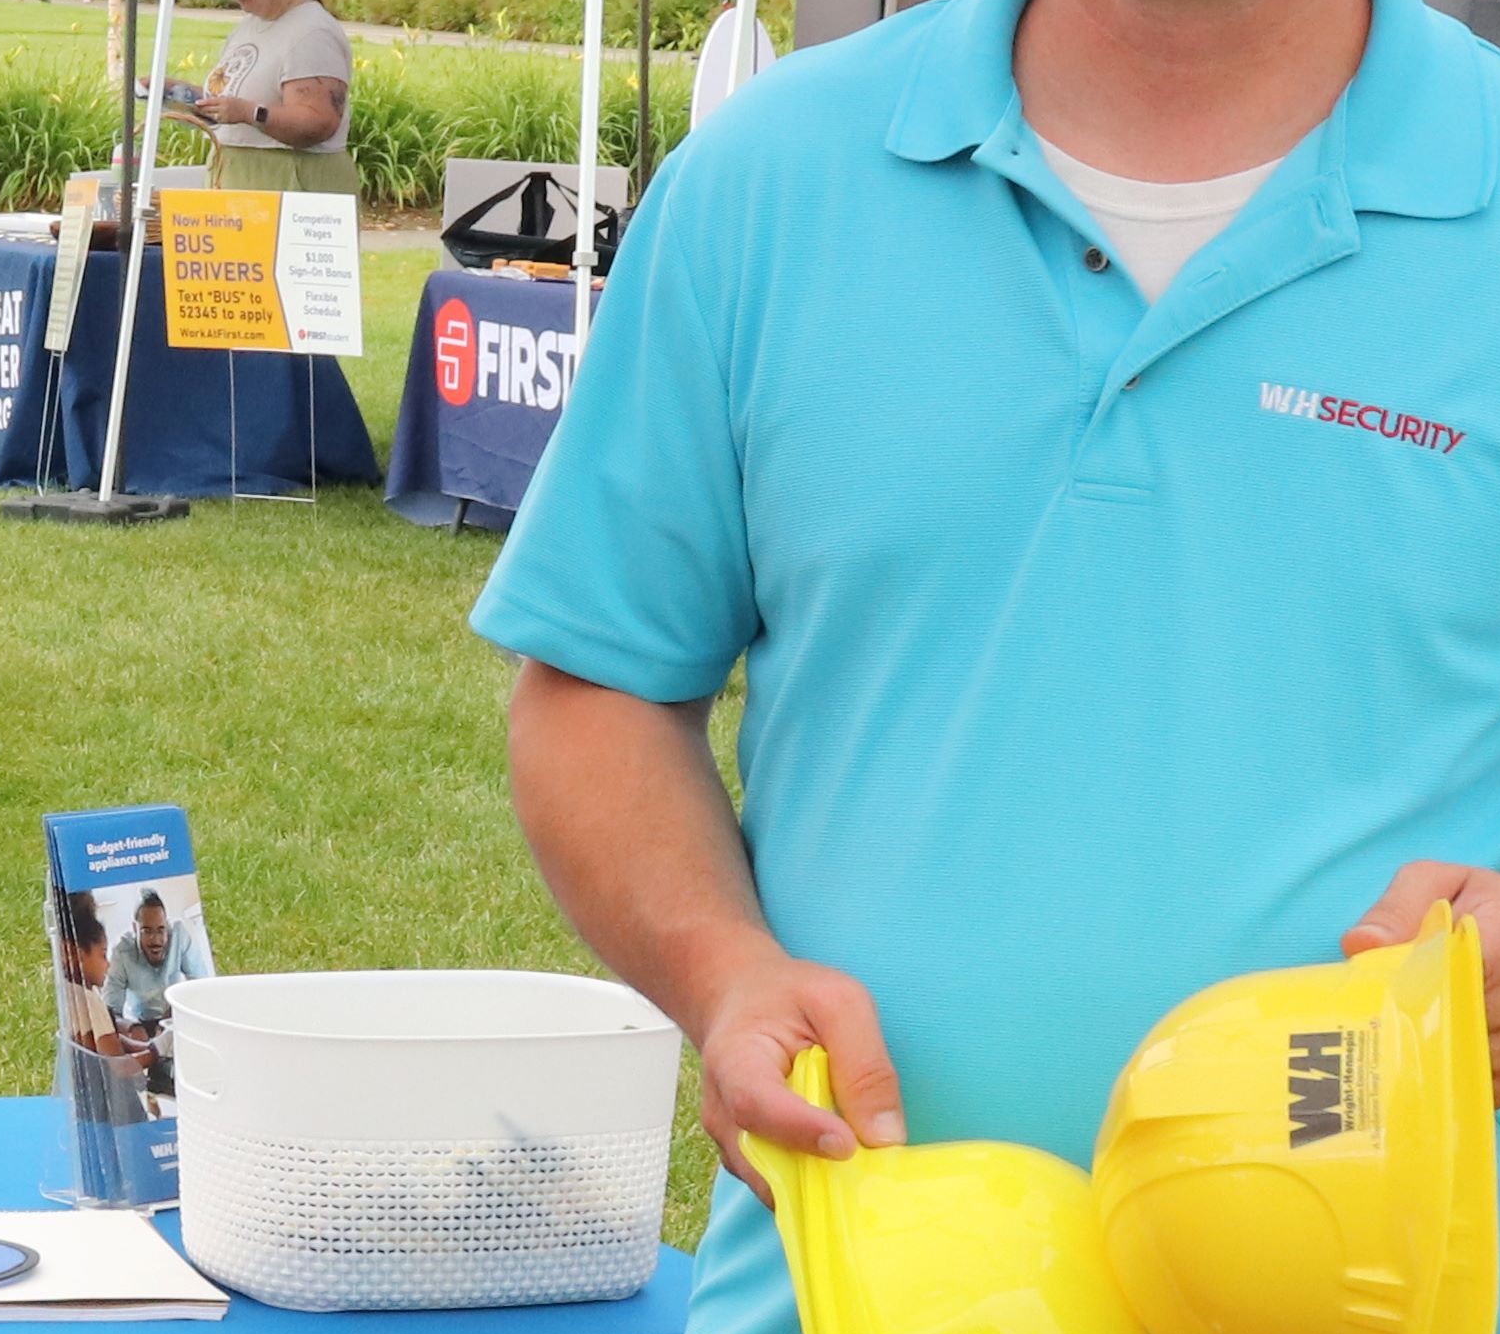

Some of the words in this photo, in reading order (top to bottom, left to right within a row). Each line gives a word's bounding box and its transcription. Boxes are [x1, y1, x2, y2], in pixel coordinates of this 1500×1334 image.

[172, 214, 199, 227] Now
[205, 215, 243, 231] Hiring
[292, 213, 342, 228] Competitive
[303, 228, 332, 240] Wages
[174, 234, 215, 254] BUS
[176, 260, 264, 282] DRIVERS
[325, 267, 352, 279] Bonus
[178, 289, 204, 303] Text
[249, 292, 262, 303] to
[305, 291, 338, 303] Flexible
[179, 306, 218, 319] 52345
[222, 308, 234, 320] to
[239, 309, 273, 324] apply
[303, 305, 342, 317] Schedule
[179, 328, 265, 340] WorkAtFirst.com
[478, 320, 577, 410] FIRST
[1260, 381, 1466, 454] WHSECURITY
[86, 833, 167, 856] Budget-friendly
[88, 855, 138, 873] appliance
[139, 849, 170, 865] repair
[1288, 1032, 1342, 1149] WH
